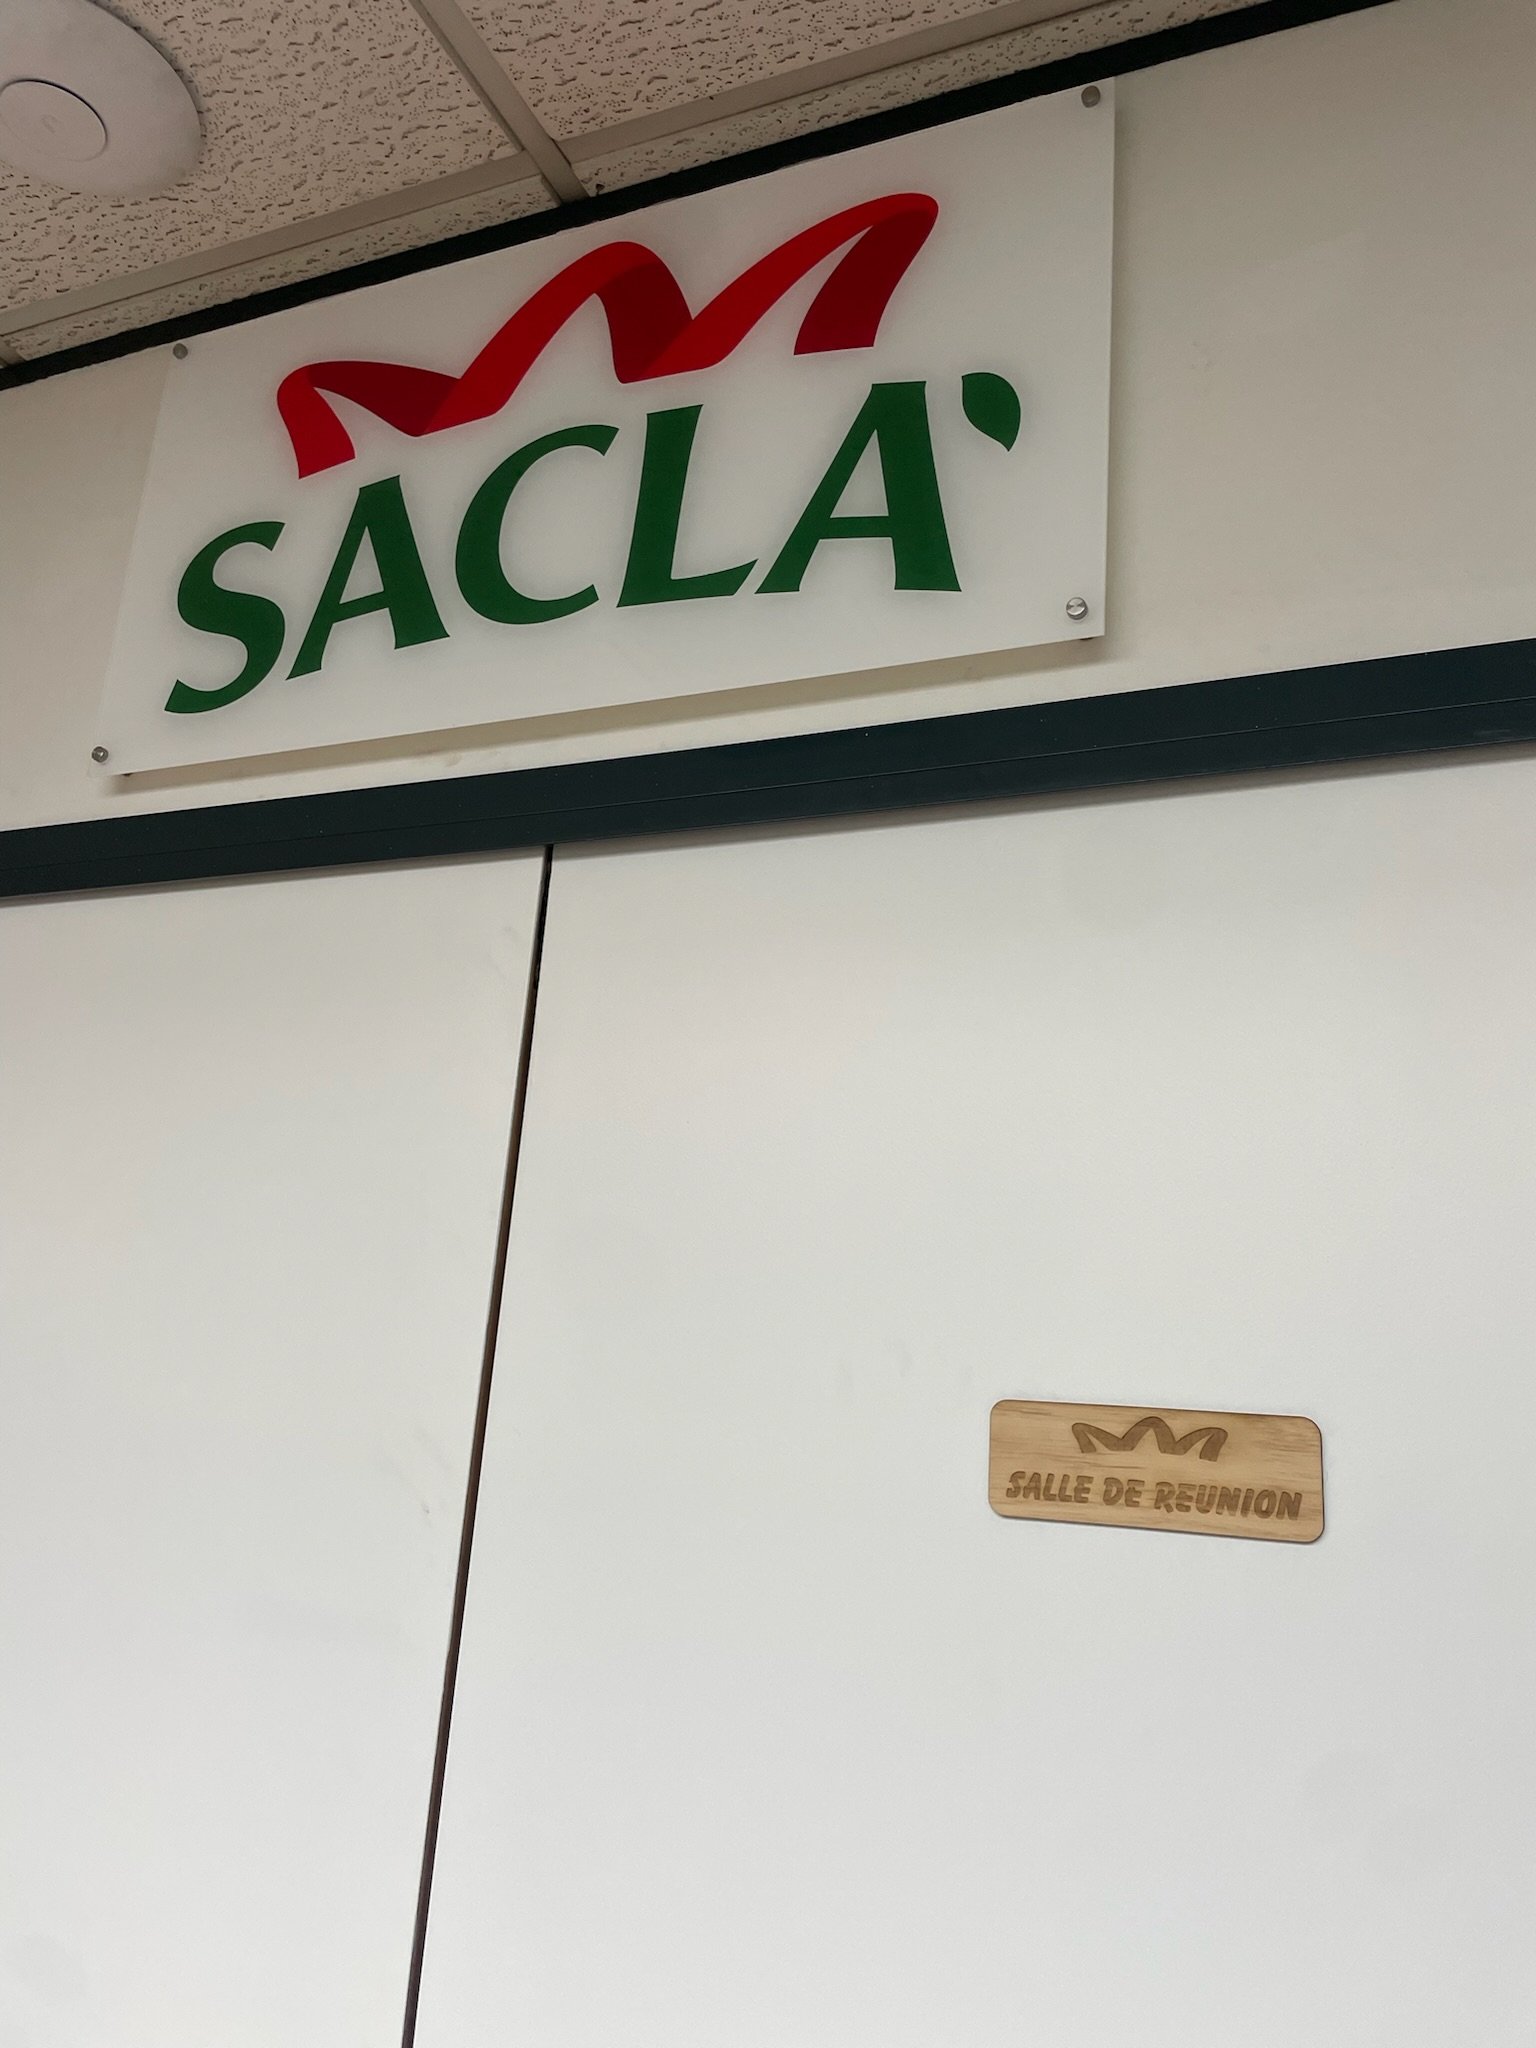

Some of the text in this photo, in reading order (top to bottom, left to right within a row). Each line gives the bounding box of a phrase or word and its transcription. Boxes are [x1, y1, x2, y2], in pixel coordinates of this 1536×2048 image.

[1005, 1471, 1303, 1520] SALLE DE REUNION
